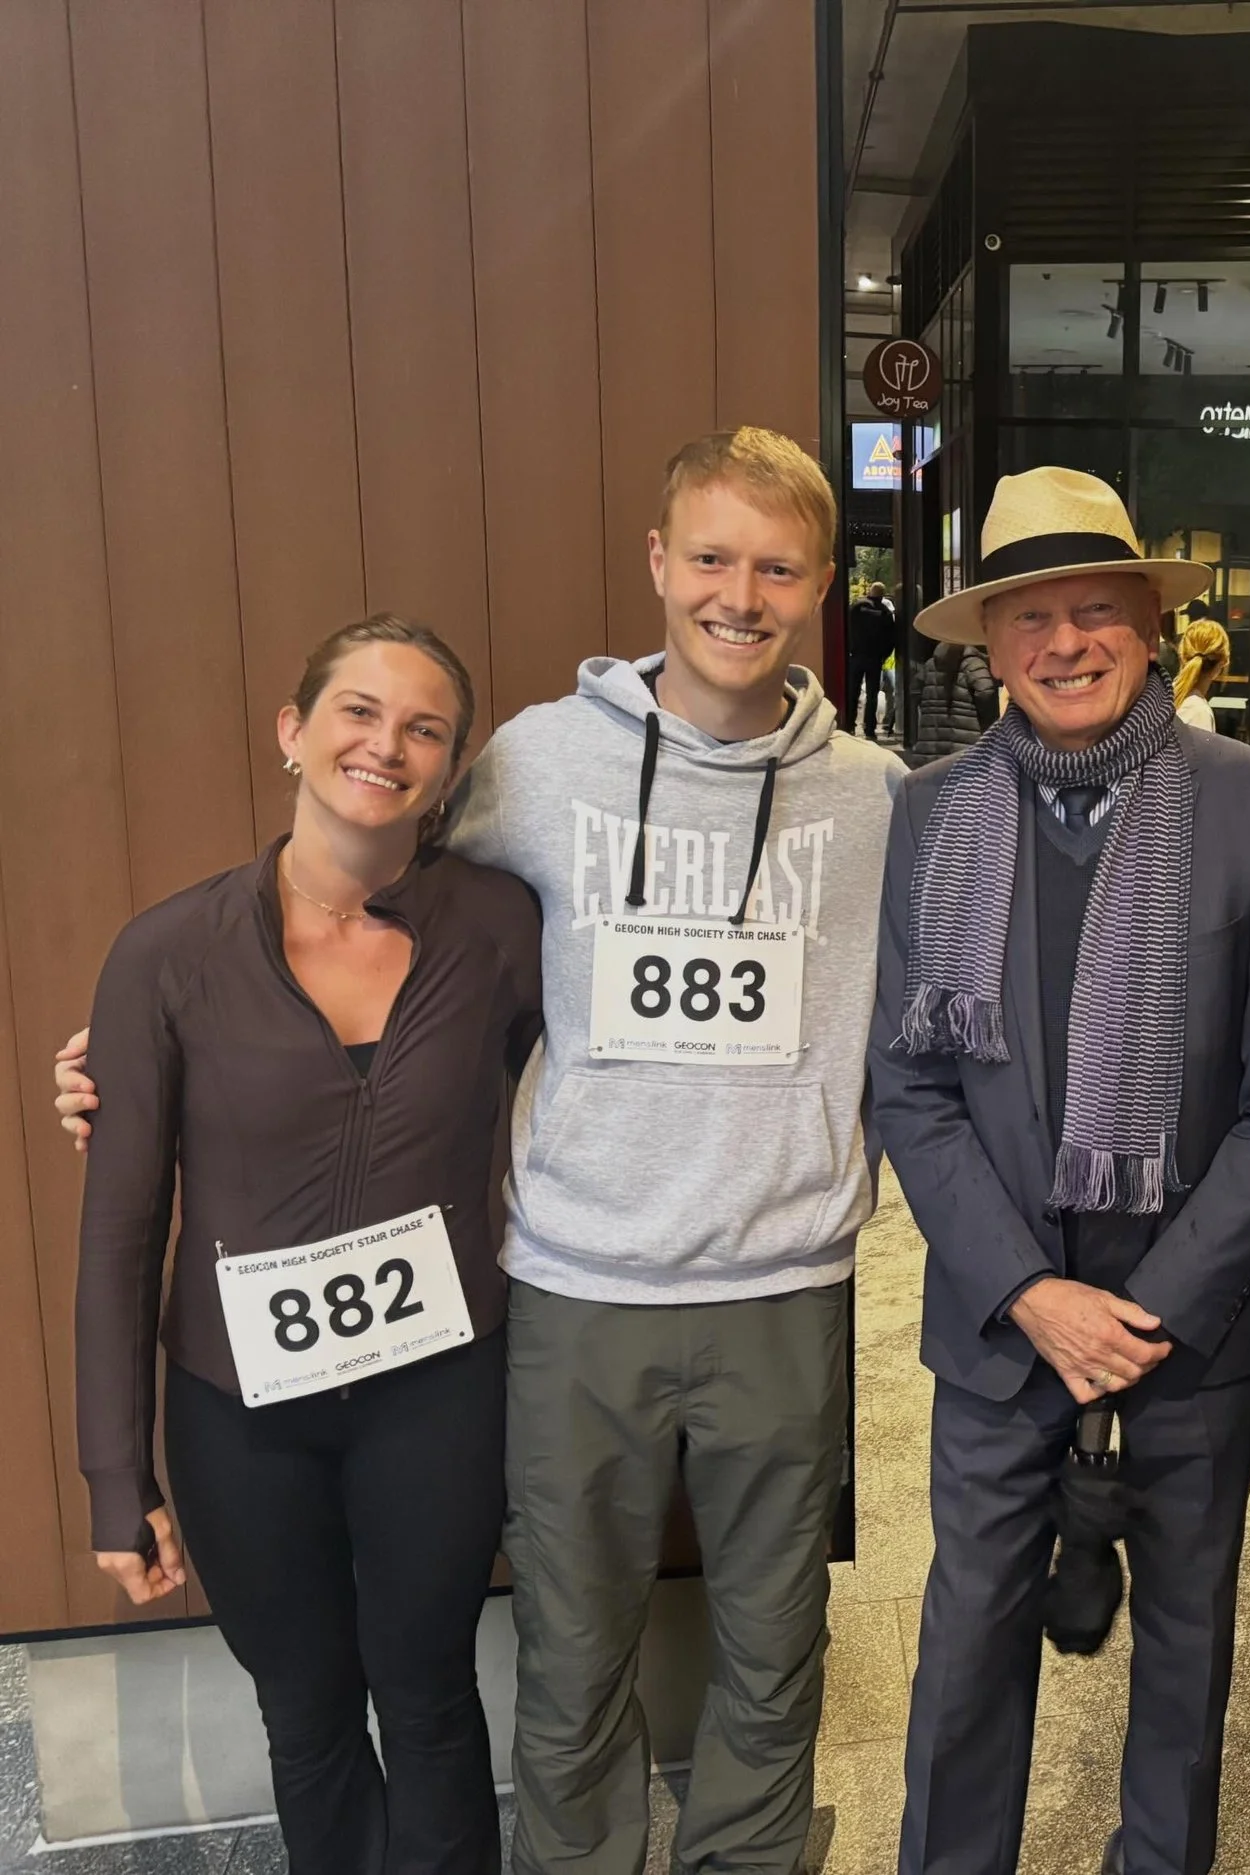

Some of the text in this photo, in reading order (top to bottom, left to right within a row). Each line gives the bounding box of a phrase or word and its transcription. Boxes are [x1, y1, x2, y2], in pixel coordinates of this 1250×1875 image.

[877, 393, 929, 412] Joy Tea
[571, 798, 834, 941] EVERLAST
[615, 923, 787, 941] GEOCON HIGH SOCIETY STAIR CHASE
[630, 955, 766, 1022] 883
[674, 1041, 716, 1051] GEOCON
[238, 1219, 424, 1275] GEOCON HIGH SOCIETY STAIR CHASE
[269, 1257, 425, 1352] 882
[335, 1350, 381, 1372] GEOCON
